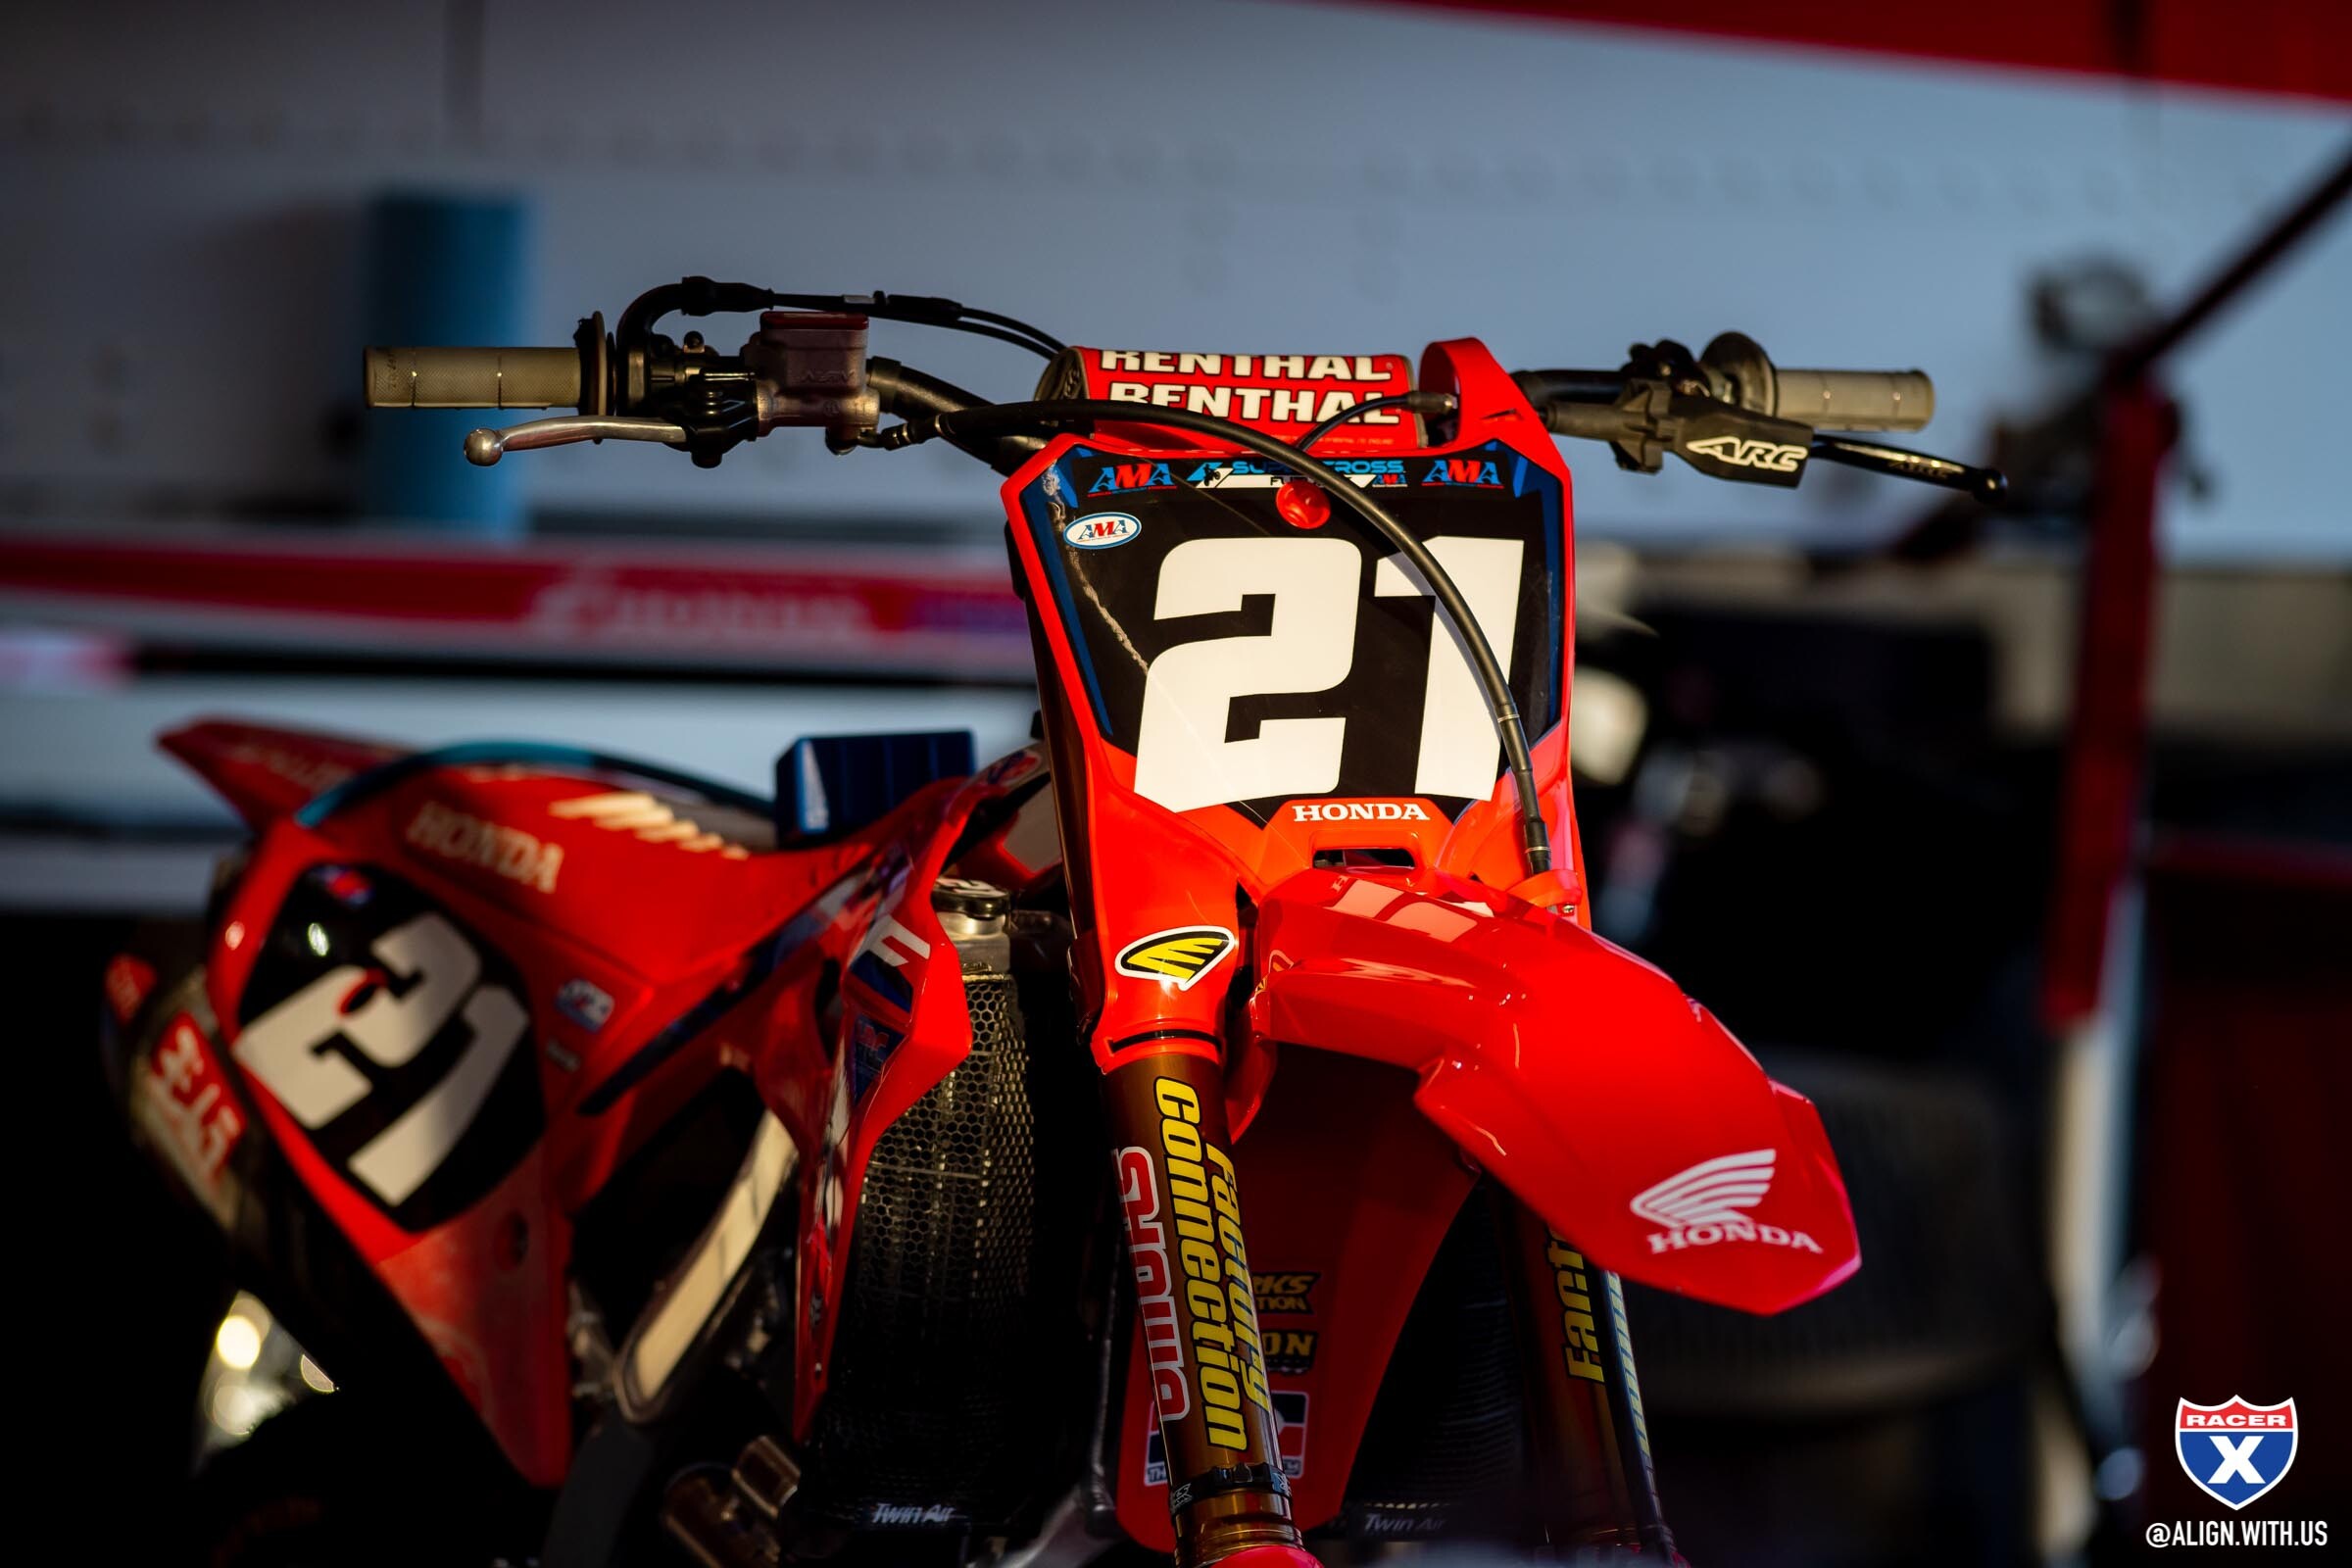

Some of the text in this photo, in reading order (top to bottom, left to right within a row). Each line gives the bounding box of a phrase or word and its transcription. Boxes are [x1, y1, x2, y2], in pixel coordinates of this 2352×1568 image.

[1109, 382, 1400, 423] RENTHAL
[1687, 436, 1808, 471] ARC
[1088, 463, 1175, 493] AMA
[1374, 474, 1406, 484] AMA
[1422, 459, 1501, 485] AMA
[1078, 519, 1128, 540] AMA
[1134, 536, 1524, 812] 21
[1293, 803, 1430, 822] HONDA
[406, 800, 564, 894] HONDA
[231, 911, 530, 1207] 21
[1647, 1222, 1823, 1254] HONDA
[1544, 1223, 1606, 1384] Fact
